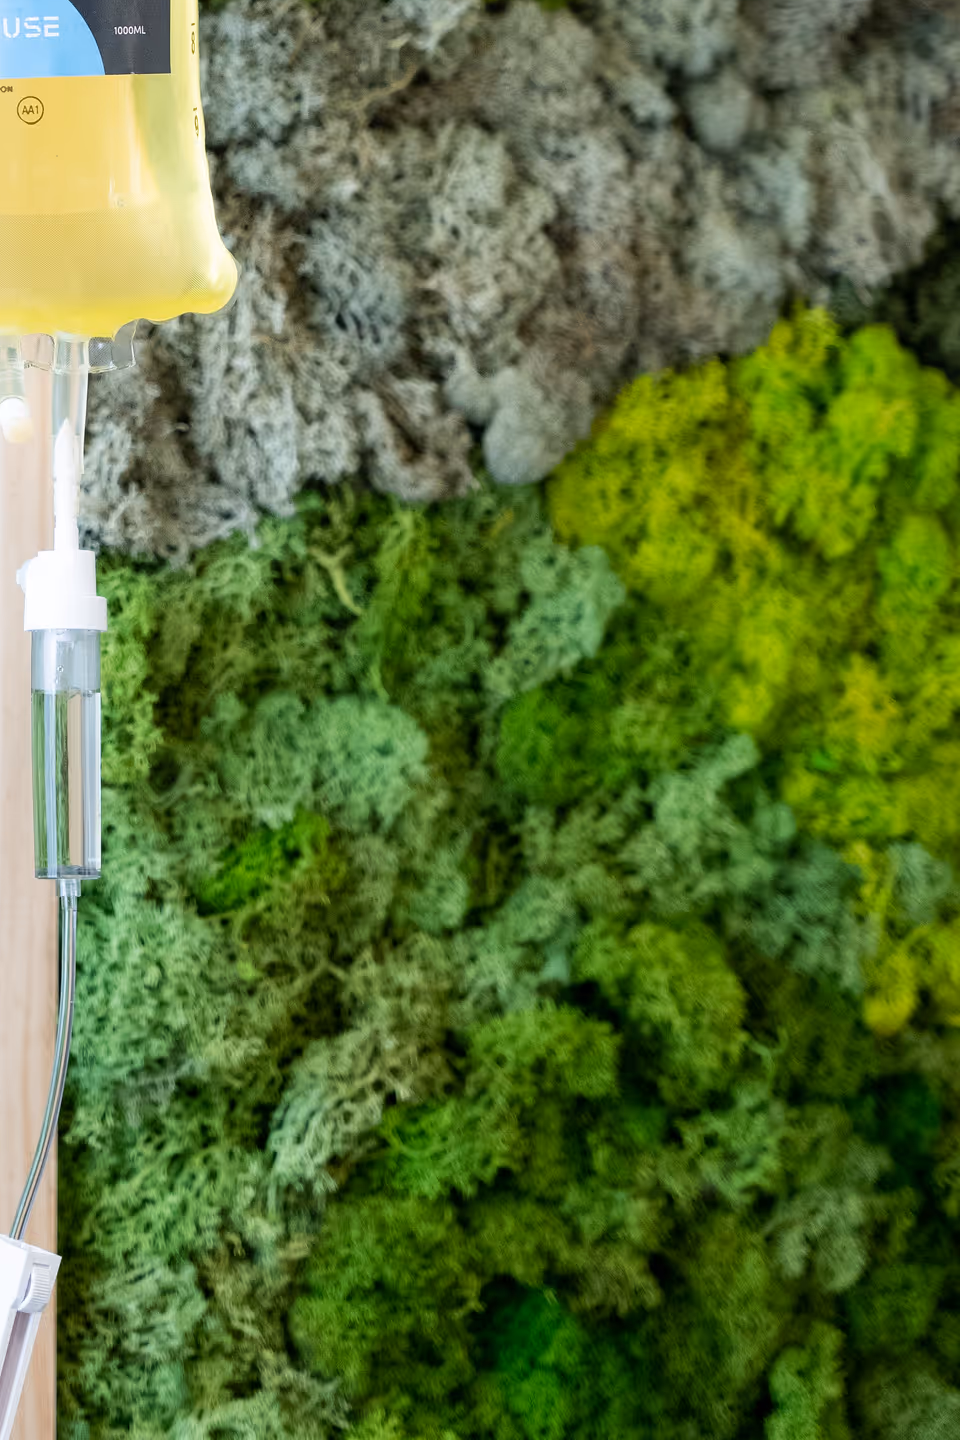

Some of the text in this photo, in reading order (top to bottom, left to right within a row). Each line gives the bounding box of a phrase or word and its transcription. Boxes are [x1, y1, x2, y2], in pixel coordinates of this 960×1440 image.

[113, 25, 146, 35] 1000ML
[191, 31, 196, 55] 8
[21, 105, 39, 115] AA1
[194, 115, 200, 138] 9
